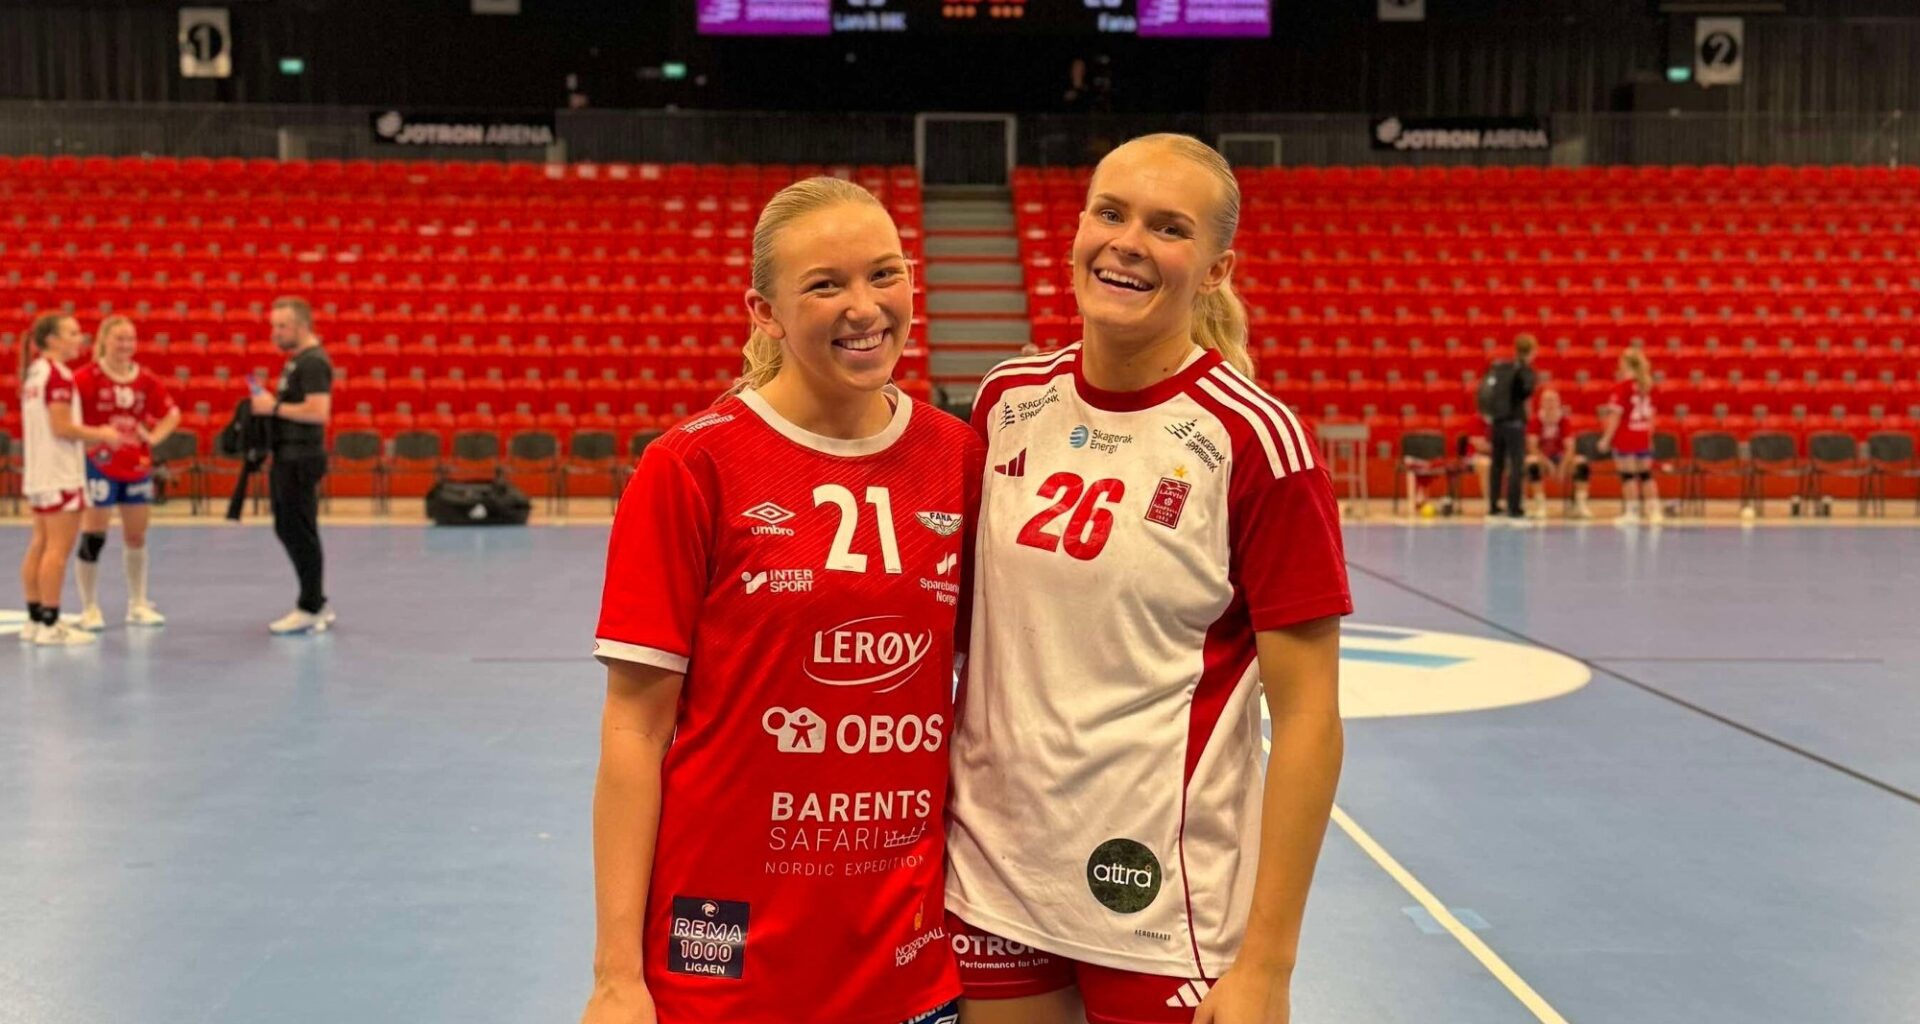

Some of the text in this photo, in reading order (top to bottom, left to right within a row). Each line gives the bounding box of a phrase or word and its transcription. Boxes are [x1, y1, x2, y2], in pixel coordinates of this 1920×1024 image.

[395, 123, 552, 144] JOTRON ARENA
[1394, 129, 1548, 149] JOTRON ARENA
[1017, 385, 1058, 412] SKAGAK
[1090, 439, 1118, 454] Energi
[1092, 429, 1133, 443] Skagerak
[929, 512, 953, 521] FANA
[1016, 471, 1125, 561] 26
[751, 524, 795, 536] umbro
[812, 483, 902, 574] 21
[770, 569, 813, 580] INTER
[770, 580, 814, 592] SPORT
[813, 630, 925, 665] LERØY
[836, 713, 944, 754] OBOS
[771, 789, 932, 822] BARENTS
[769, 826, 879, 852] SAFARI
[765, 861, 834, 876] NORDIC
[674, 917, 742, 942] REMA
[680, 940, 732, 962] 1000
[950, 933, 1036, 956] OTRO
[684, 962, 726, 975] LIGAEN
[959, 960, 1016, 969] Performance
